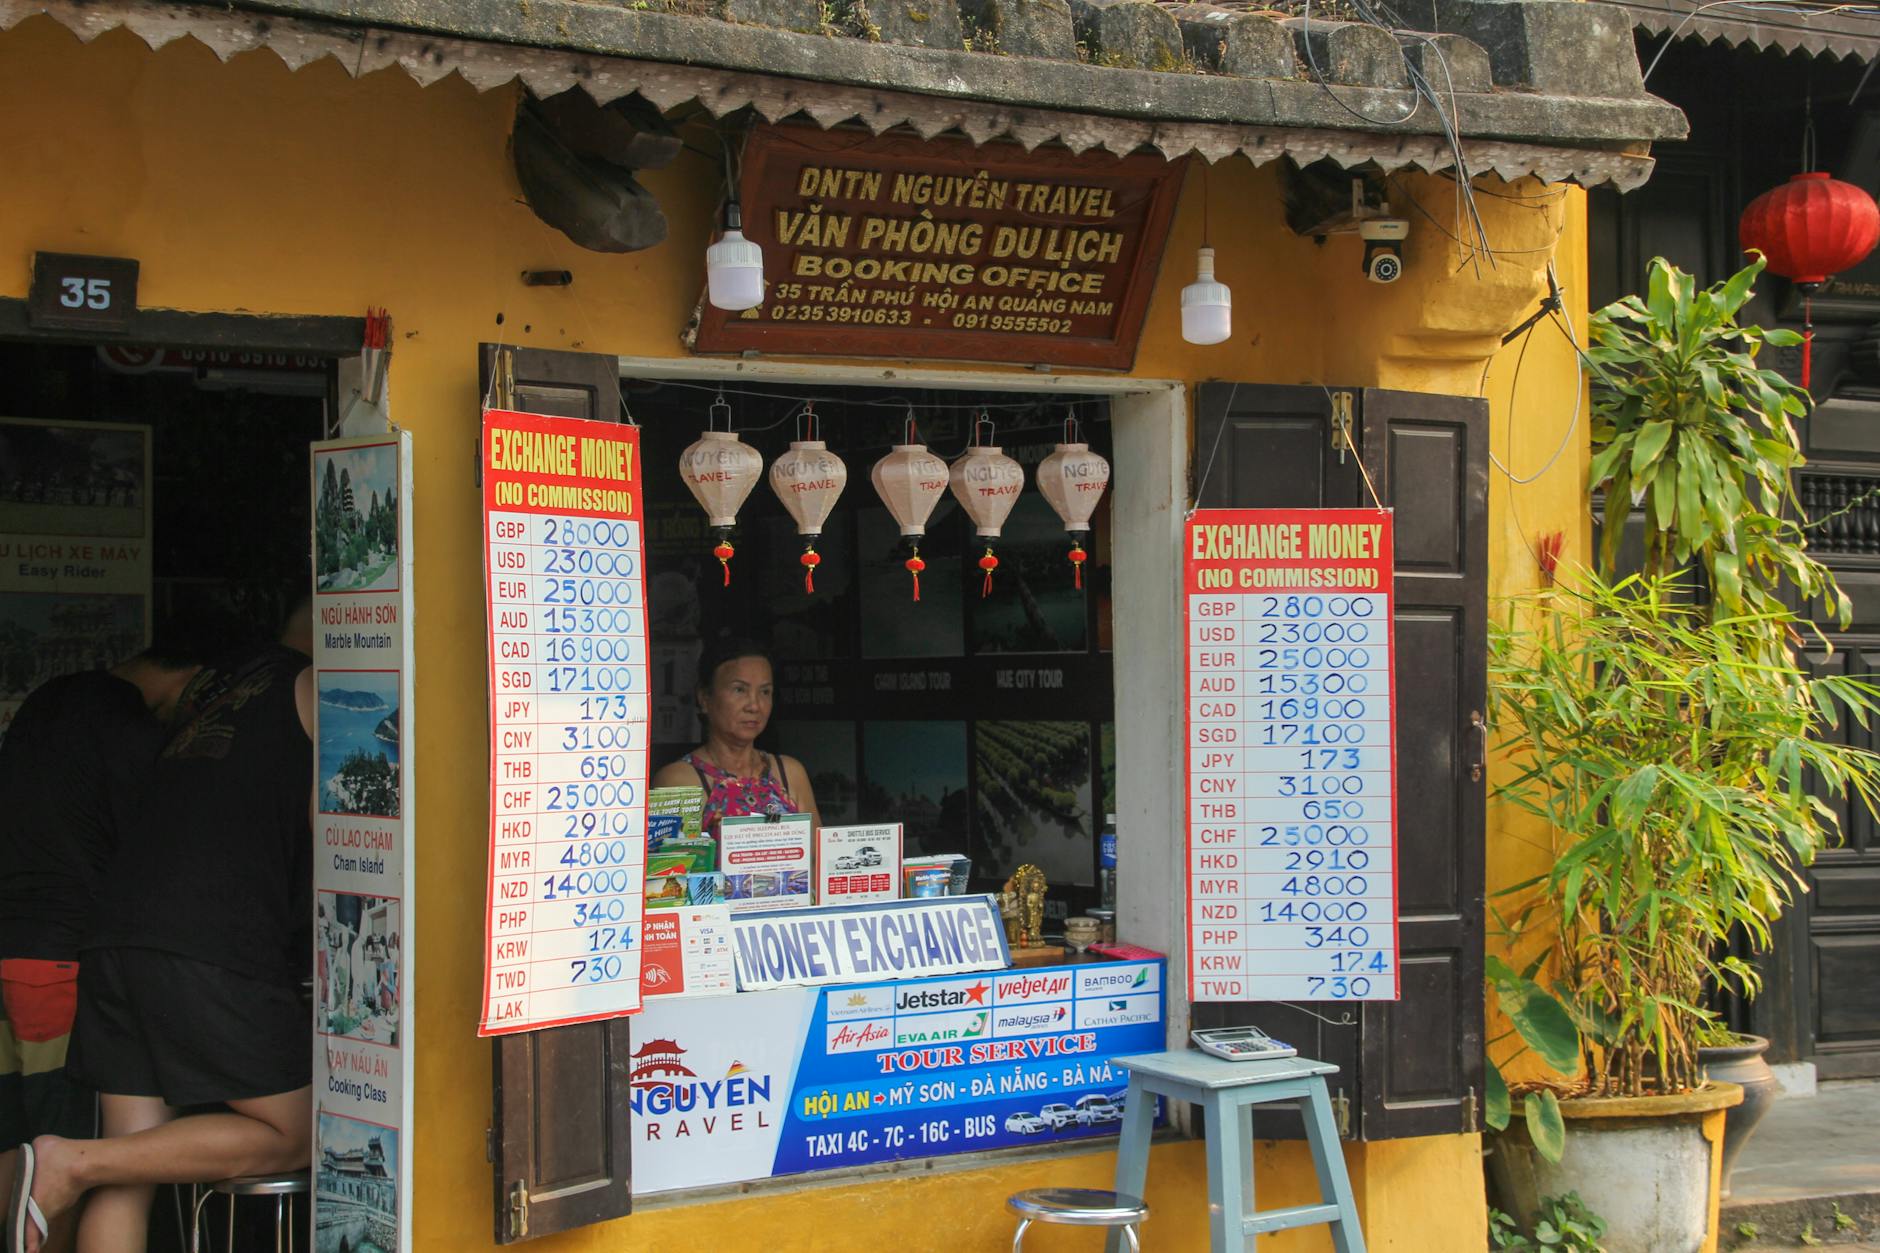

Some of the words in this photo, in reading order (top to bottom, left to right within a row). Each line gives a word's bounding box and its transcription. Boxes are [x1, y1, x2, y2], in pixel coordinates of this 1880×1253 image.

[800, 167, 882, 201] DNTN
[892, 169, 1008, 210] NGUYÊN
[1016, 183, 1116, 217] TRAVEL
[777, 204, 851, 248] VĂN
[861, 208, 984, 256] PHÒNG
[993, 226, 1042, 259] DU
[1044, 230, 1124, 268] LỊCH
[796, 255, 976, 285] BOOKING
[982, 267, 1105, 294] OFFICE
[60, 277, 111, 310] 35
[776, 283, 801, 300] 35
[808, 279, 865, 304] TRẦN
[872, 285, 915, 307] PHÚ
[923, 287, 955, 314] HỘI
[962, 294, 994, 310] AN
[1000, 289, 1065, 314] QUẢNG
[1070, 299, 1114, 317] NAM
[953, 314, 1072, 334] 0919555502
[491, 428, 577, 477] EXCHANGE
[581, 437, 633, 481] MONEY
[495, 481, 523, 506] (NO
[527, 483, 633, 516] COMMISSION)
[496, 520, 525, 540] GBP
[543, 519, 629, 547] 28000
[1192, 524, 1302, 560] EXCHANGE
[1309, 524, 1383, 559] MONEY
[69, 546, 93, 559] XE
[497, 551, 525, 570] USD
[543, 549, 634, 577] 23000
[20, 564, 58, 579] Easy
[64, 565, 106, 578] Rider
[1198, 568, 1233, 590] (NO
[1239, 568, 1379, 589] COMMISSION)
[499, 581, 526, 600] EUR
[543, 578, 632, 606] 25000
[321, 602, 344, 625] NGŨ
[345, 601, 372, 624] HÀNH
[1198, 602, 1236, 617] GBP
[1262, 596, 1373, 618] 28000
[500, 611, 528, 629] AUD
[543, 607, 631, 633] 15300
[325, 632, 352, 649] Marble
[354, 633, 392, 650] Mountain
[1199, 627, 1236, 642] USD
[1259, 622, 1369, 643] 23000
[501, 641, 530, 659] CAD
[546, 636, 630, 663] 16900
[1200, 653, 1236, 667] EUR
[1259, 646, 1370, 670] 25000
[502, 671, 532, 689] SGD
[548, 667, 631, 692] 17100
[1038, 669, 1064, 688] TOUR
[1200, 678, 1236, 692] AUD
[1259, 673, 1368, 695] 15300
[504, 701, 530, 719] JPY
[580, 695, 628, 721] 173
[1199, 702, 1237, 718] CAD
[1260, 697, 1366, 720] 16900
[503, 731, 532, 749] CNY
[562, 725, 631, 751] 3100
[1199, 728, 1237, 743] SGD
[1263, 723, 1366, 745] 17100
[503, 761, 532, 779] THB
[580, 754, 626, 780] 650
[1201, 754, 1235, 768] JPY
[1300, 747, 1361, 770] 173
[503, 791, 532, 809] CHF
[546, 781, 634, 810] 25000
[1200, 779, 1237, 793] CNY
[1278, 775, 1363, 796] 3100
[1200, 804, 1237, 818] THB
[1303, 800, 1363, 820] 650
[501, 821, 531, 840] HKD
[564, 812, 628, 838] 2910
[1201, 829, 1237, 843] CHF
[1260, 824, 1368, 846] 25000
[342, 828, 361, 849] LAO
[334, 855, 357, 873] Cham
[359, 857, 385, 876] Island
[501, 851, 530, 869] MYR
[560, 841, 625, 871] 4800
[1200, 854, 1238, 868] HKD
[1285, 849, 1369, 871] 2910
[501, 881, 528, 900] NZD
[543, 870, 628, 900] 14000
[1200, 879, 1239, 894] MYR
[1281, 876, 1368, 896] 4800
[499, 911, 527, 929] PHP
[573, 898, 625, 928] 340
[1202, 905, 1237, 919] NZD
[1260, 901, 1368, 922] 14000
[497, 940, 528, 960] KRW
[588, 925, 633, 952] 17.4
[734, 920, 841, 983] MONEY
[842, 907, 1000, 973] EXCHANGE
[1202, 930, 1238, 945] PHP
[1305, 926, 1369, 948] 340
[496, 970, 526, 990] TWD
[571, 955, 622, 983] 730
[1201, 956, 1242, 970] KRW
[1330, 950, 1389, 974] 17.4
[1084, 974, 1133, 988] BAMBOO
[1201, 981, 1242, 996] TWD
[1307, 976, 1371, 999] 730
[496, 1001, 523, 1021] LAK
[897, 989, 967, 1010] Jetstar
[998, 1014, 1050, 1029] malaysia
[897, 1032, 928, 1044] EVA
[930, 1029, 958, 1040] AIR
[877, 1046, 964, 1075] TOUR
[969, 1032, 1097, 1064] SERVICE
[328, 1076, 362, 1101] Cooking
[363, 1082, 388, 1103] Class
[804, 1091, 838, 1119] HỘI
[843, 1091, 870, 1111] AN
[889, 1082, 915, 1106] MỸ
[919, 1080, 956, 1103] SƠN
[970, 1072, 996, 1097] ĐÀ
[1062, 1063, 1087, 1087] BÀ
[1090, 1060, 1113, 1083] NÀ
[647, 1110, 770, 1142] RAVEL
[806, 1133, 843, 1158] TAXI
[847, 1129, 868, 1151] 4C
[884, 1125, 904, 1148] 7C
[919, 1120, 949, 1144] 16C
[964, 1115, 996, 1139] BUS
